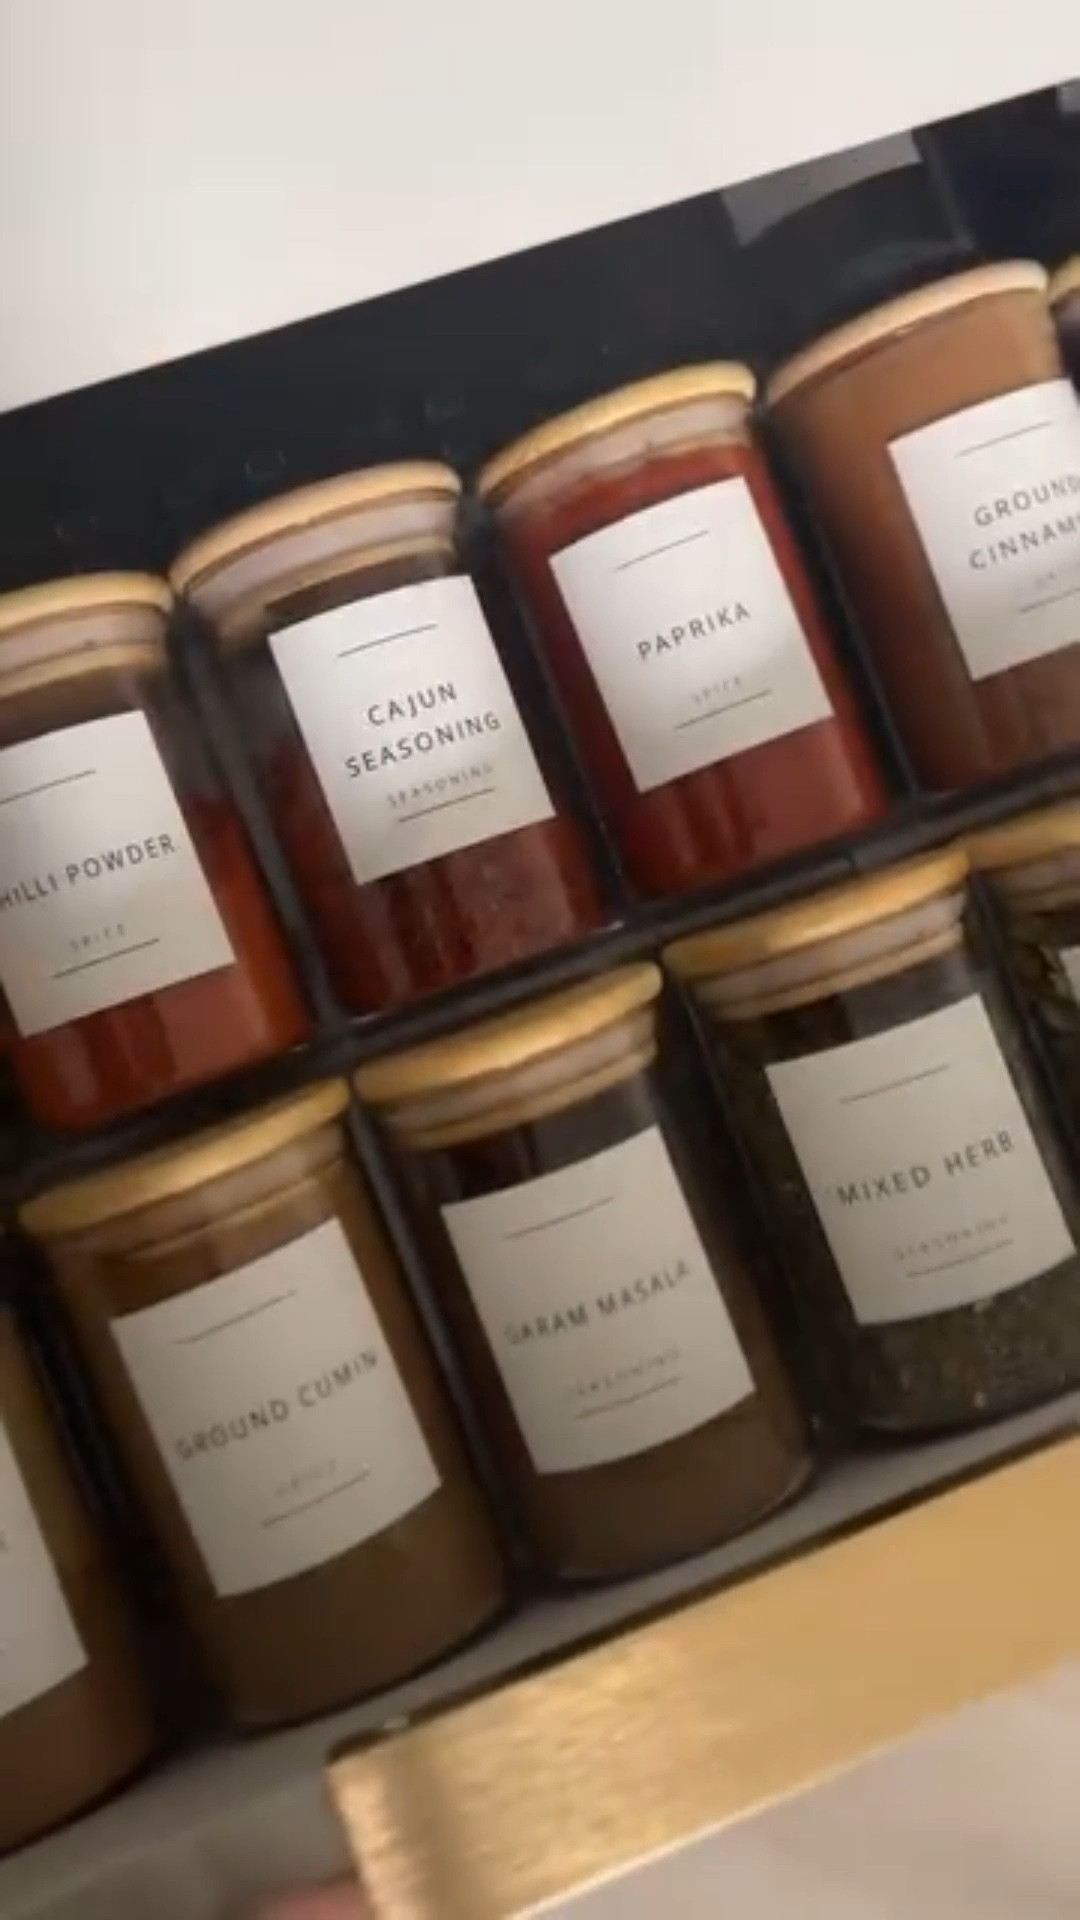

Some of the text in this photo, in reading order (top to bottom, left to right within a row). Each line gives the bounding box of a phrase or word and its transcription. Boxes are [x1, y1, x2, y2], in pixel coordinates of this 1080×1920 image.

[968, 513, 1080, 570] CINNAM
[637, 602, 751, 662] PAPRIKA
[367, 682, 457, 727] CAJUN
[344, 711, 502, 779] SEASONING
[387, 762, 494, 808] SEASONING
[0, 833, 175, 911] HILLI POWDER
[836, 1129, 1012, 1206] MIXED HERB
[504, 1258, 689, 1344] GARAM MASALA
[175, 1350, 377, 1461] GROUND CUMIN
